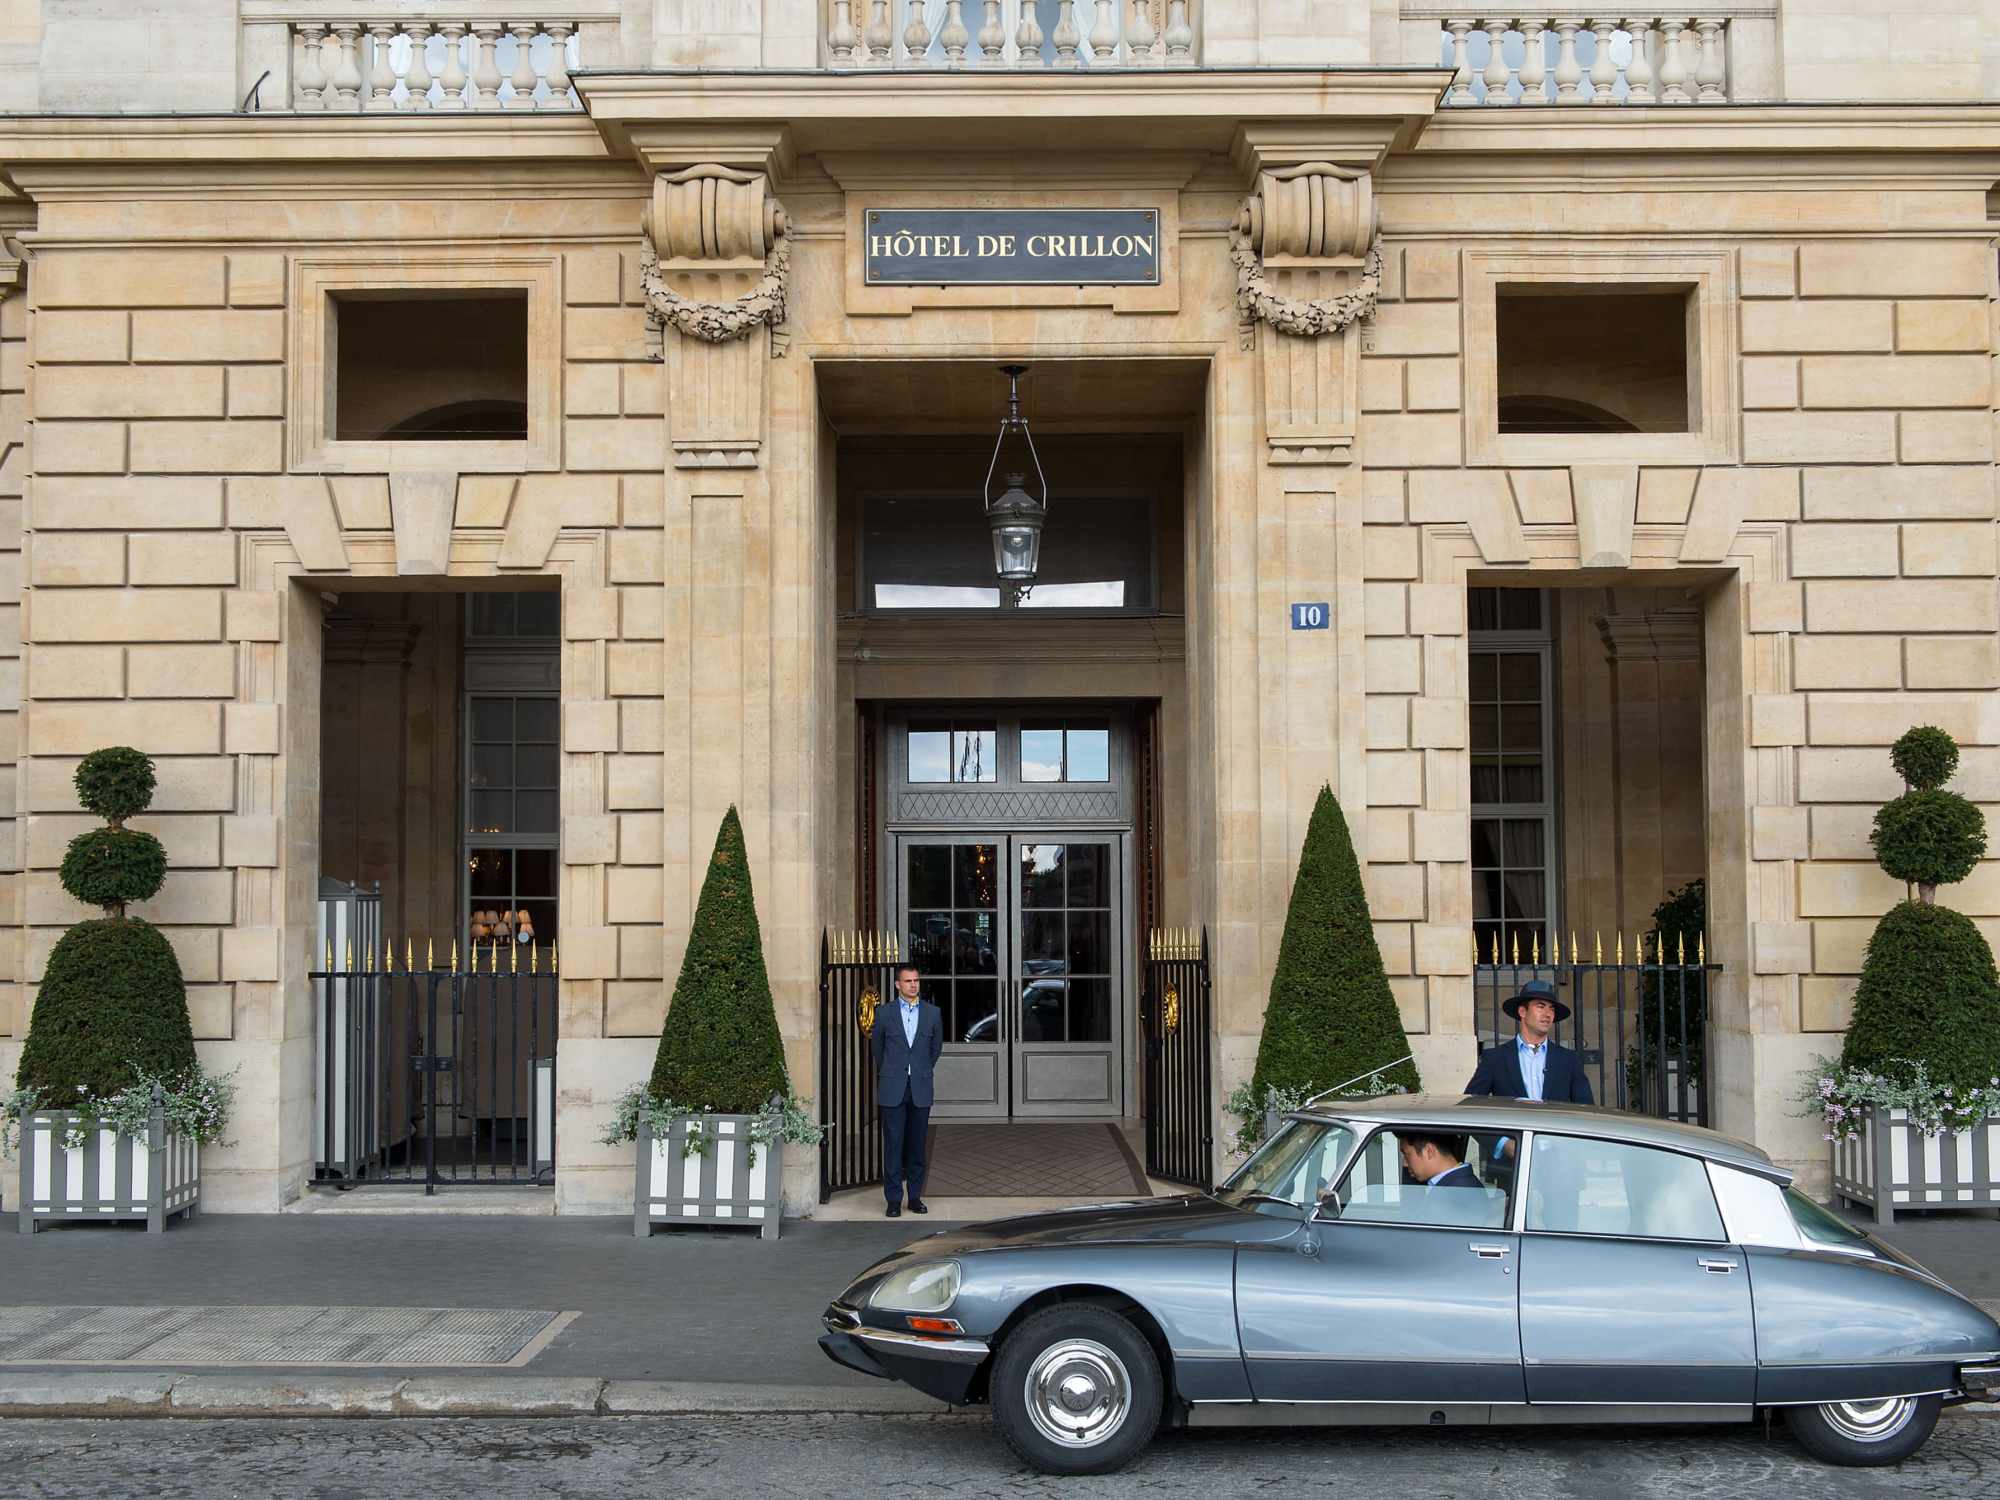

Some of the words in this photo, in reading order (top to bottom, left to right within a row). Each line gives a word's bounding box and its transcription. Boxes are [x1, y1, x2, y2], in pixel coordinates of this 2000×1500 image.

[870, 229, 969, 257] HÔTEL
[977, 235, 1016, 257] DE
[1026, 235, 1153, 257] CRILLON
[1299, 606, 1321, 626] 10
